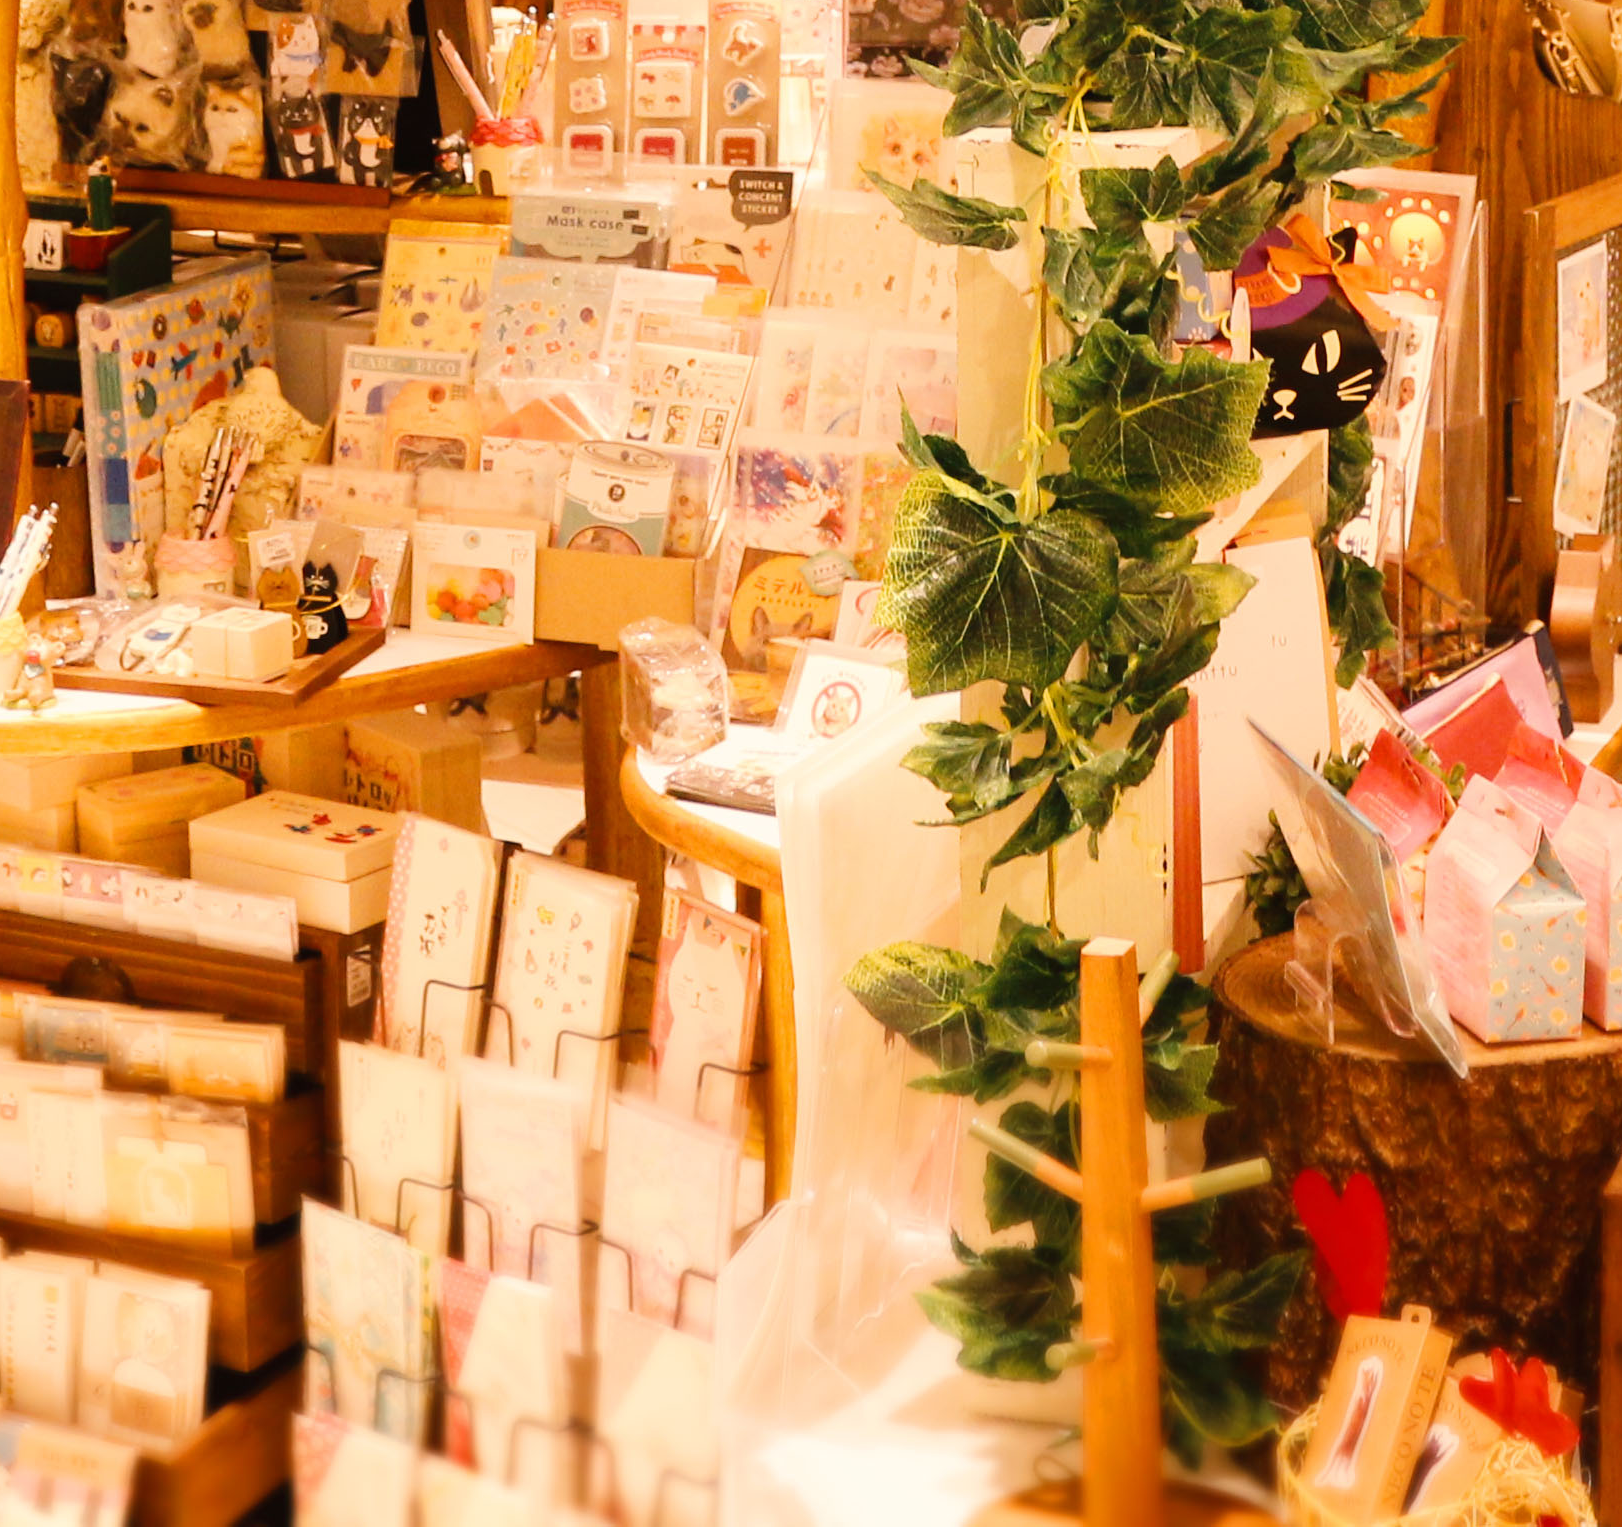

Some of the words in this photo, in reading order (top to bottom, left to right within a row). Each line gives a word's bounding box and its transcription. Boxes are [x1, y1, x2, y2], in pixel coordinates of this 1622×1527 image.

[739, 179, 776, 191] SWITCH
[738, 191, 783, 203] CONCENT
[742, 204, 779, 215] STICKER
[546, 215, 584, 228] Mask
[589, 219, 624, 230] case
[1416, 1367, 1436, 1395] TE
